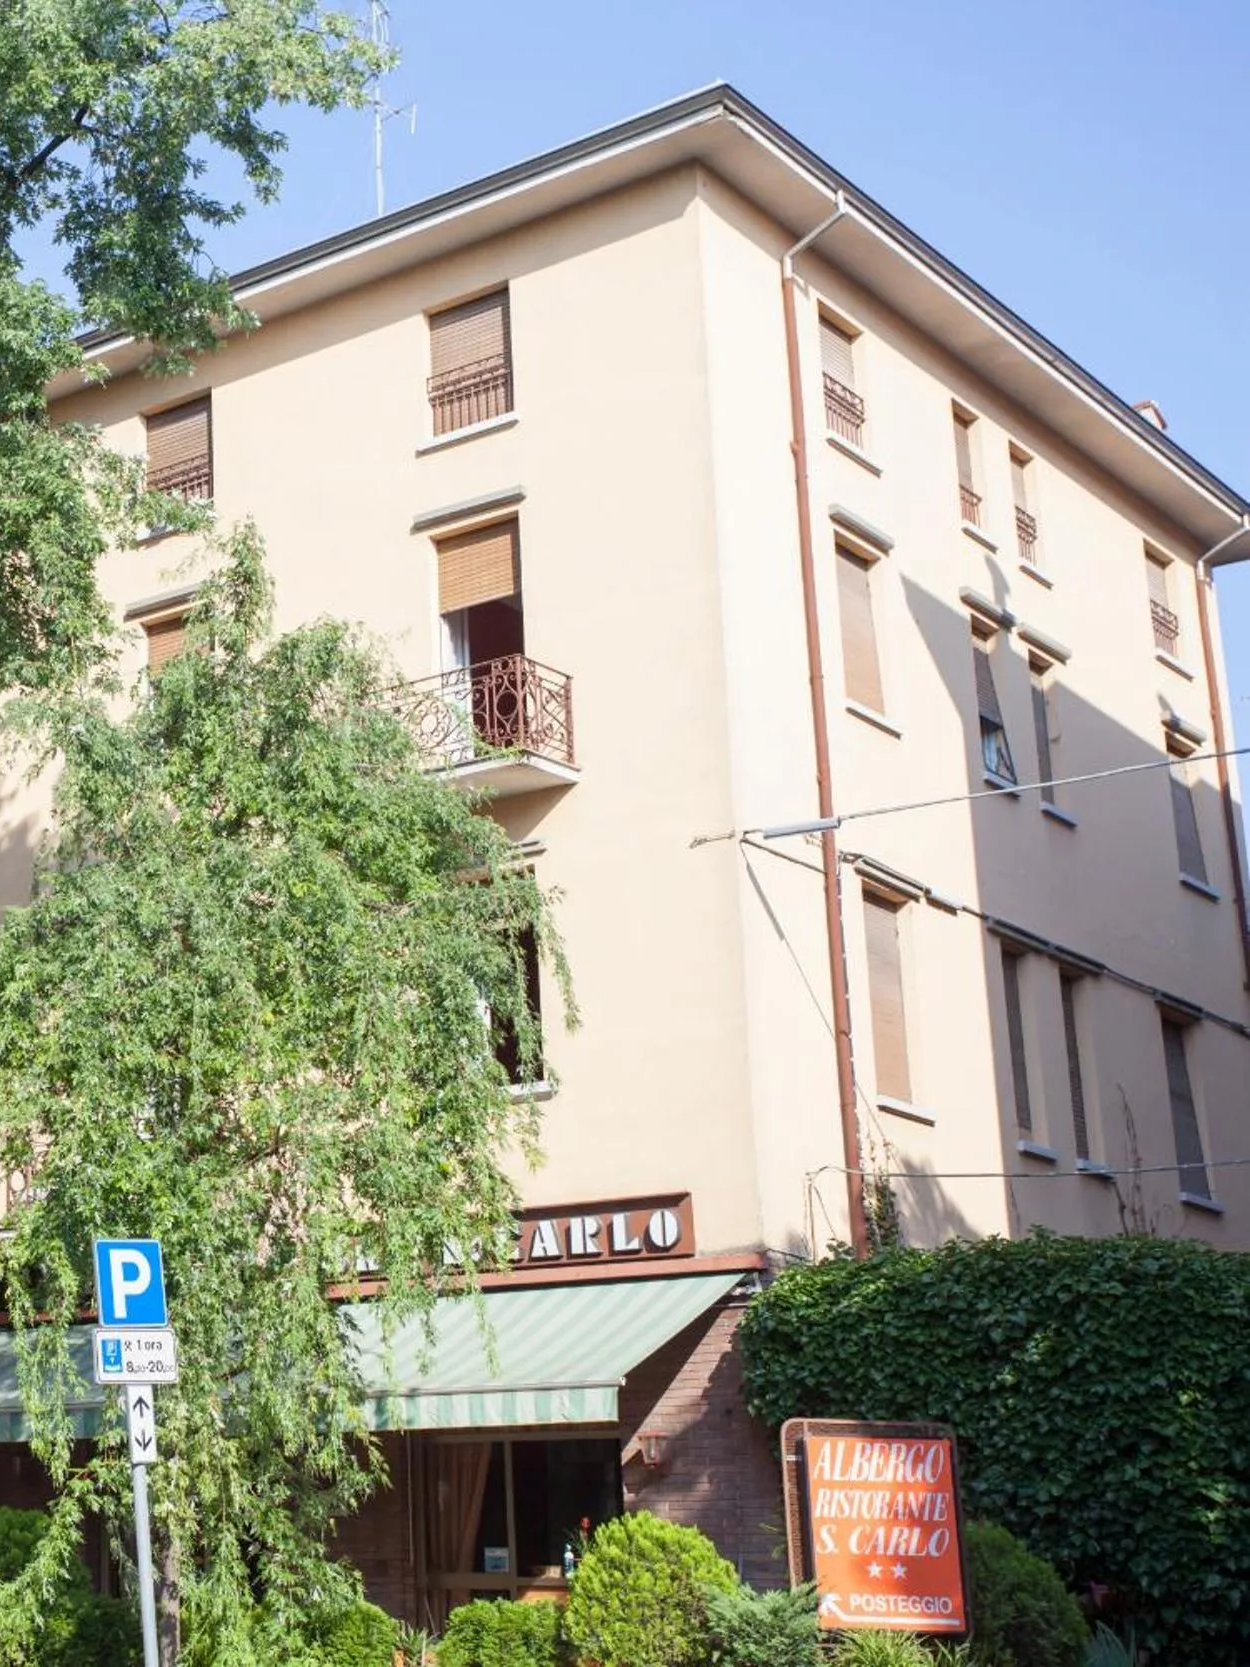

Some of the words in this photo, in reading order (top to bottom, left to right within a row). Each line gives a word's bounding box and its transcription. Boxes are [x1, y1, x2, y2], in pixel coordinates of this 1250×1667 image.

[109, 1248, 152, 1319] P
[144, 1341, 162, 1351] ora
[814, 1439, 945, 1483] ALBERGO
[815, 1487, 949, 1521] RISTORANTE
[848, 1525, 950, 1557] CARLO
[849, 1593, 953, 1614] POSTEGGIO
